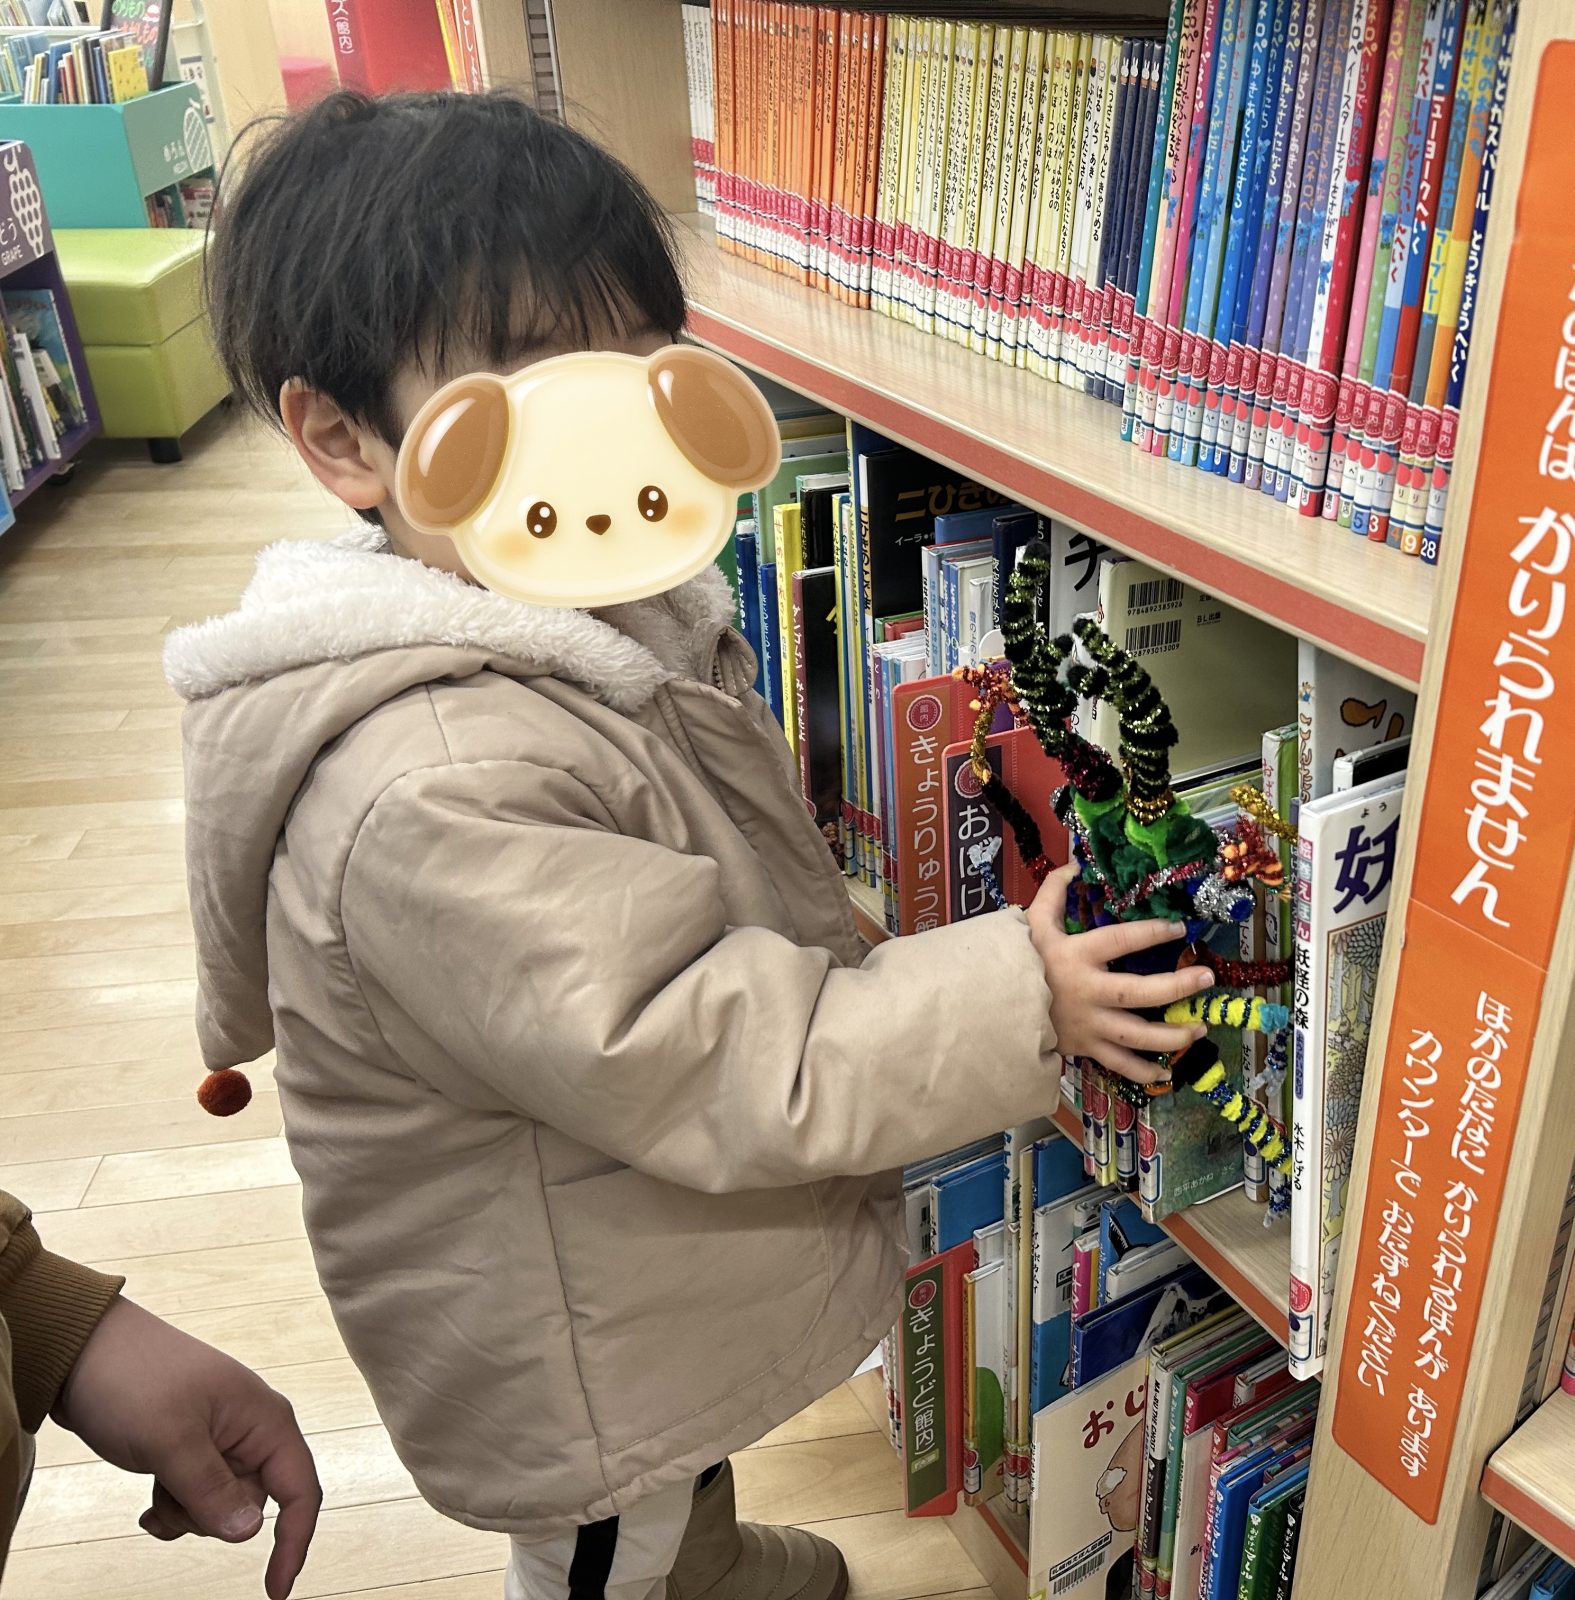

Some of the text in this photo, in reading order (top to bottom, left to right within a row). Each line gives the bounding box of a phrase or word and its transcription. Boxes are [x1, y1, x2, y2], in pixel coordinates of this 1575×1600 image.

[1, 245, 23, 266] GRAPE
[1353, 512, 1364, 529] 5
[1369, 515, 1379, 532] 3
[1405, 535, 1418, 552] 9
[1420, 540, 1436, 559] 28
[1127, 601, 1183, 616] 9784892385926
[1130, 643, 1180, 658] 28793013009
[1450, 507, 1575, 927] かりられません
[1294, 1121, 1305, 1190] 水木しげる
[1357, 1027, 1444, 1397] カウンターで おたずねください
[1399, 990, 1514, 1478] ほかのたなに かりられるほんが あります
[909, 1307, 937, 1456] きょうど(館内)
